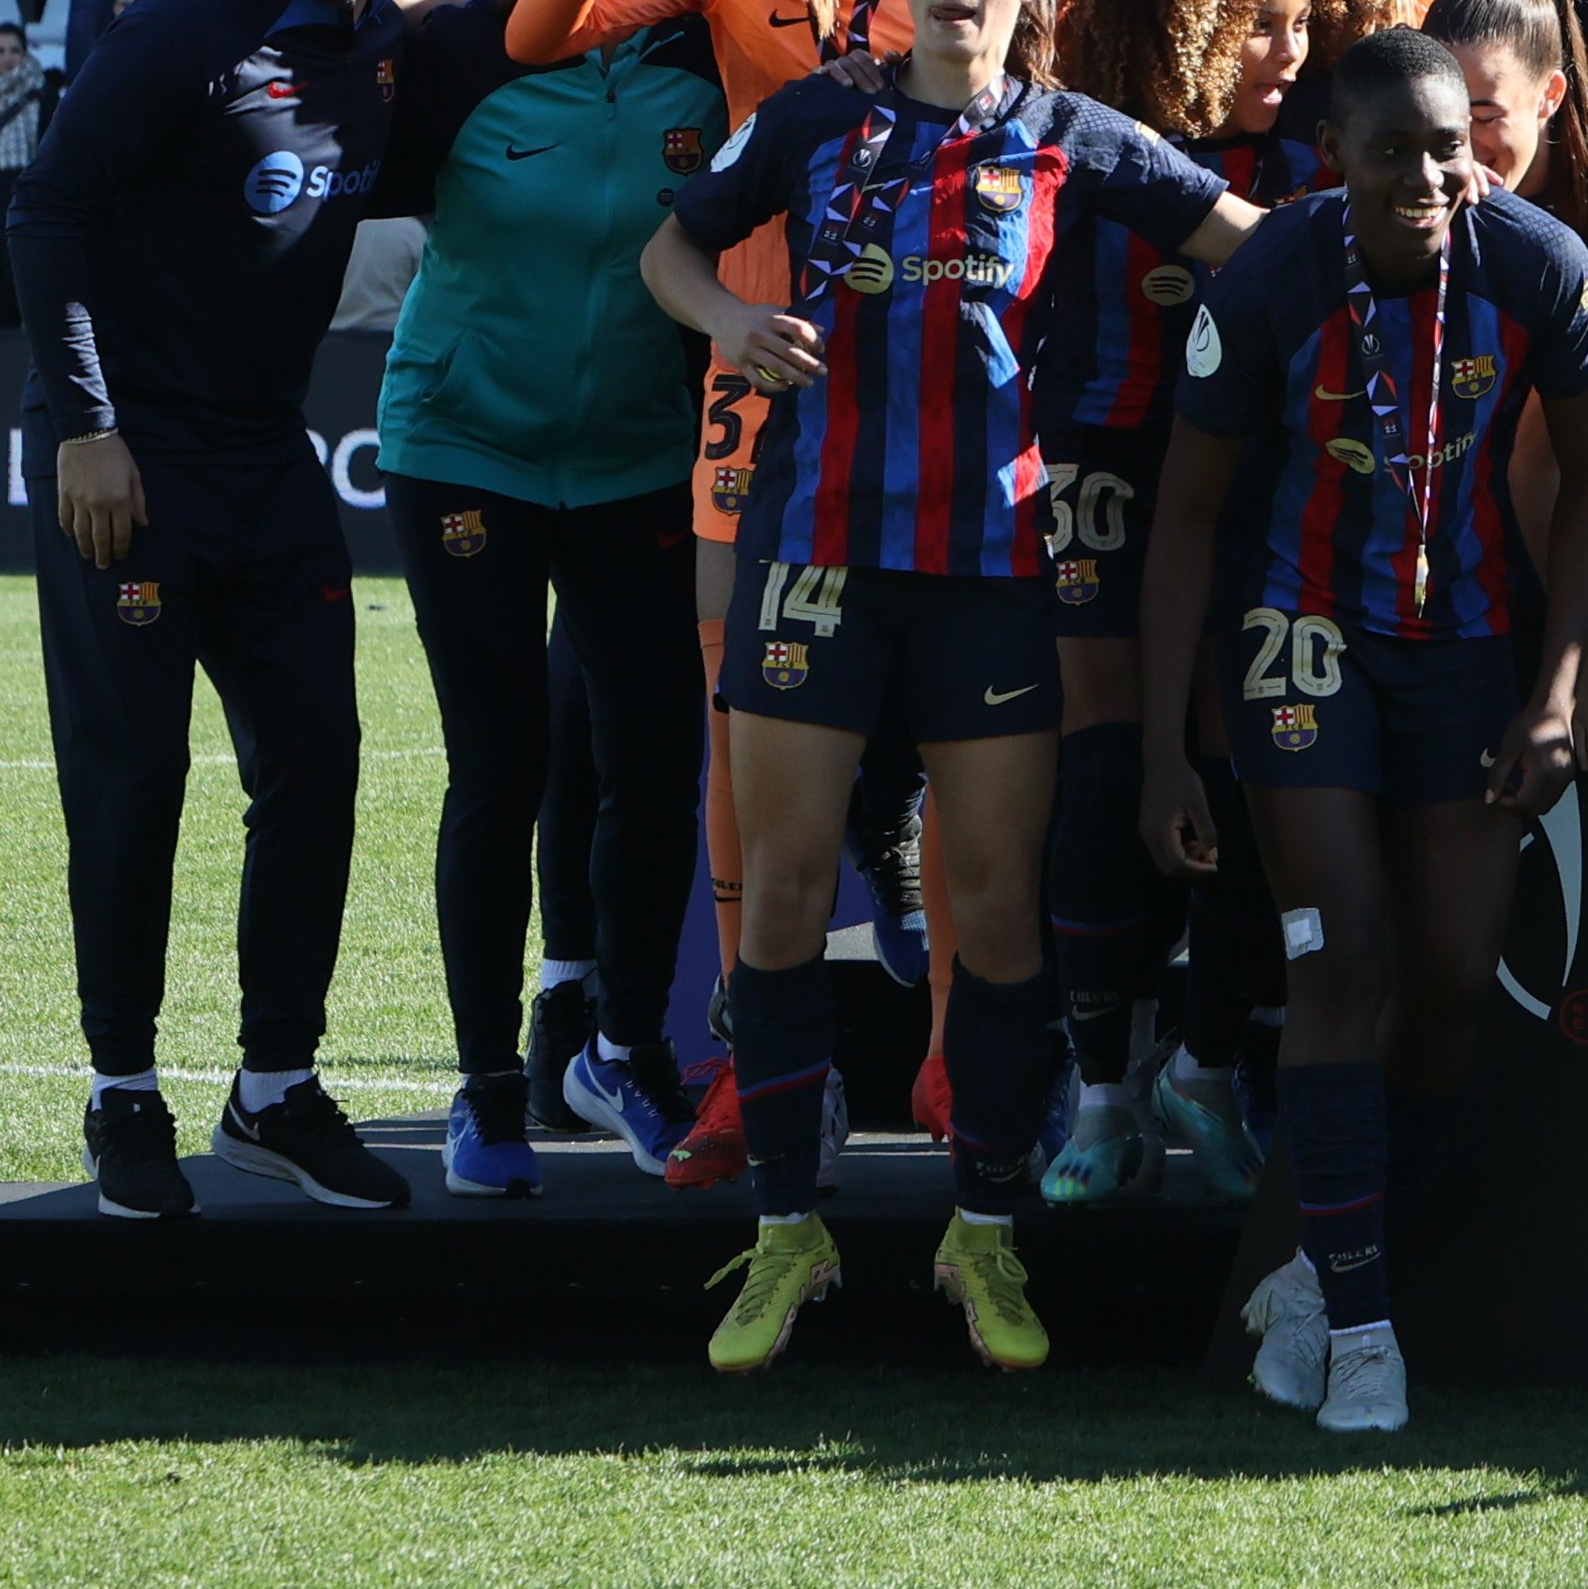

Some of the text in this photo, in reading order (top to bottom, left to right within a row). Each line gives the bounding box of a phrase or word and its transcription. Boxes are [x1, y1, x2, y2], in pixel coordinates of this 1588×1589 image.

[901, 253, 1015, 289] Spotify
[704, 373, 766, 464] 3
[758, 560, 848, 639] 14
[1241, 607, 1348, 701] 20
